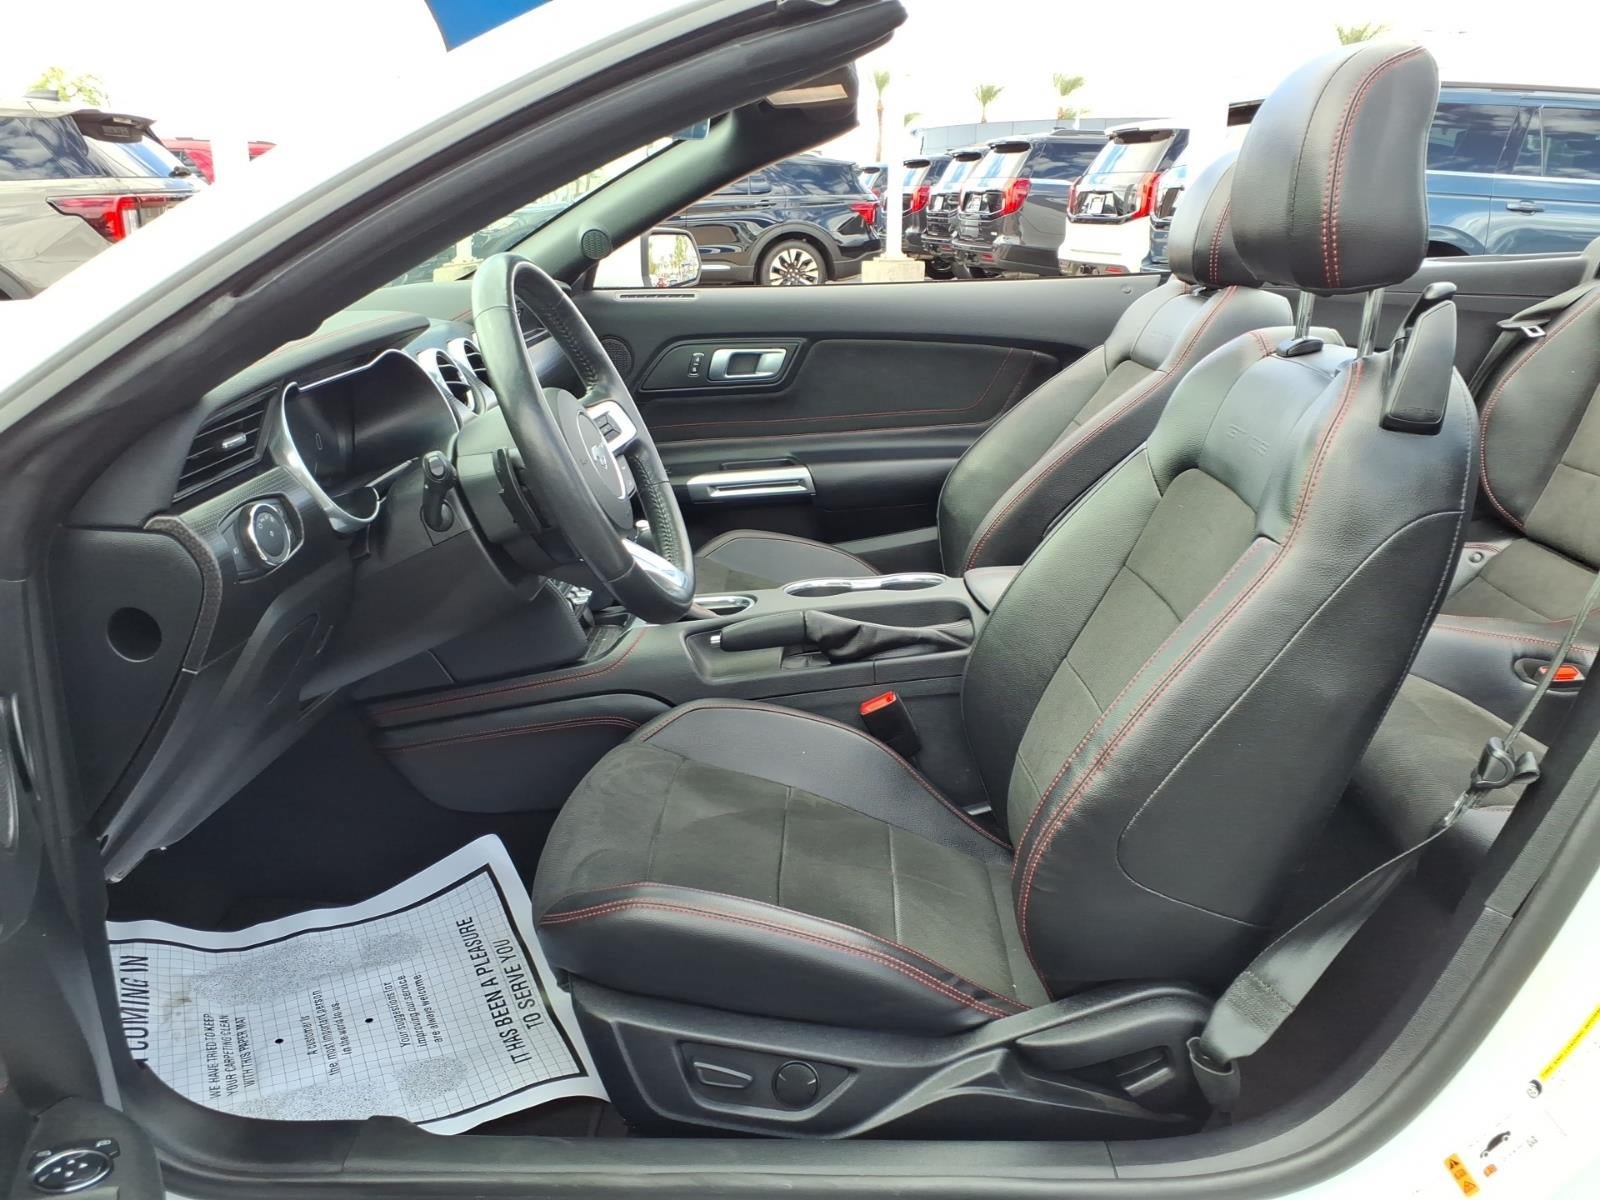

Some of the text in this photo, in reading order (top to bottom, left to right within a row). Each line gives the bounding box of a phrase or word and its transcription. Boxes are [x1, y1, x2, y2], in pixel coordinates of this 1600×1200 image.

[120, 955, 149, 972] IN
[456, 916, 533, 1064] IT HAS BEEN A PLEASURE
[492, 939, 544, 1030] TO SERVE YOU
[121, 977, 150, 1052] COMING
[302, 1022, 316, 1049] customer
[312, 990, 340, 1075] the most important person
[333, 1011, 342, 1019] to
[334, 1019, 346, 1035] world
[339, 1036, 350, 1046] the
[383, 982, 411, 1048] Your suggestions for
[397, 975, 427, 1048] improving our service
[413, 974, 443, 1043] are always welcome
[203, 1014, 221, 1099] WE HAVE TRIED TO KEEP
[219, 1015, 239, 1096] YOUR CARPETING CLEAN
[235, 1016, 255, 1087] WITH THIS PAPER MAT
